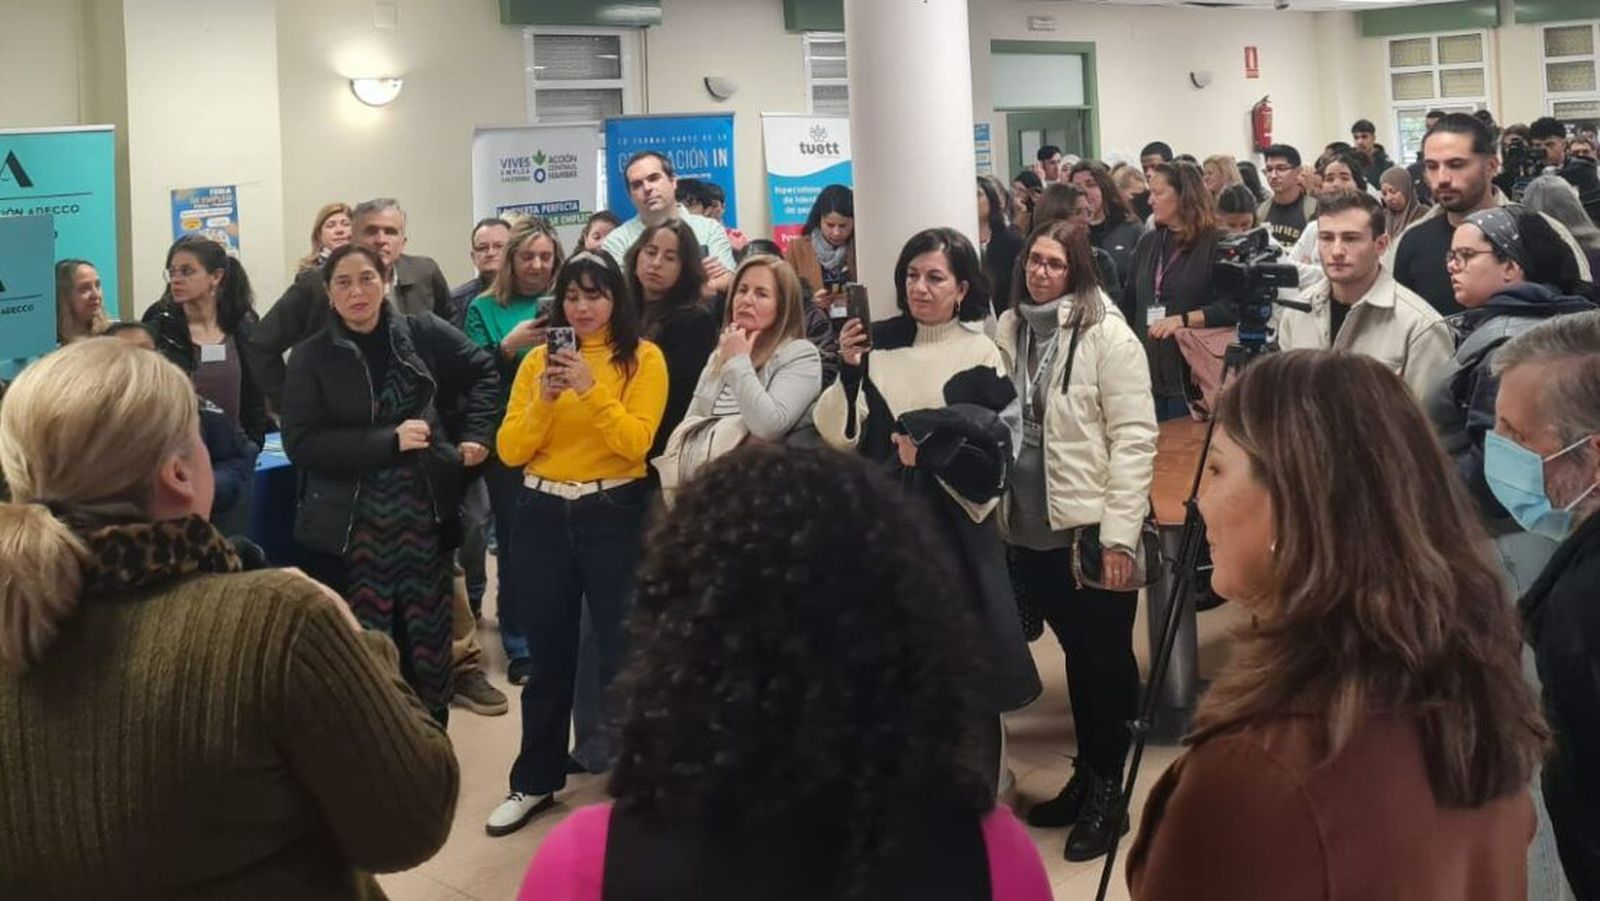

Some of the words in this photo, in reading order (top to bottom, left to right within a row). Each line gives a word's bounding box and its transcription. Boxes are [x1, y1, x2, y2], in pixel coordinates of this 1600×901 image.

[799, 141, 840, 155] tuett
[500, 156, 531, 169] VIVES
[713, 147, 729, 168] IN
